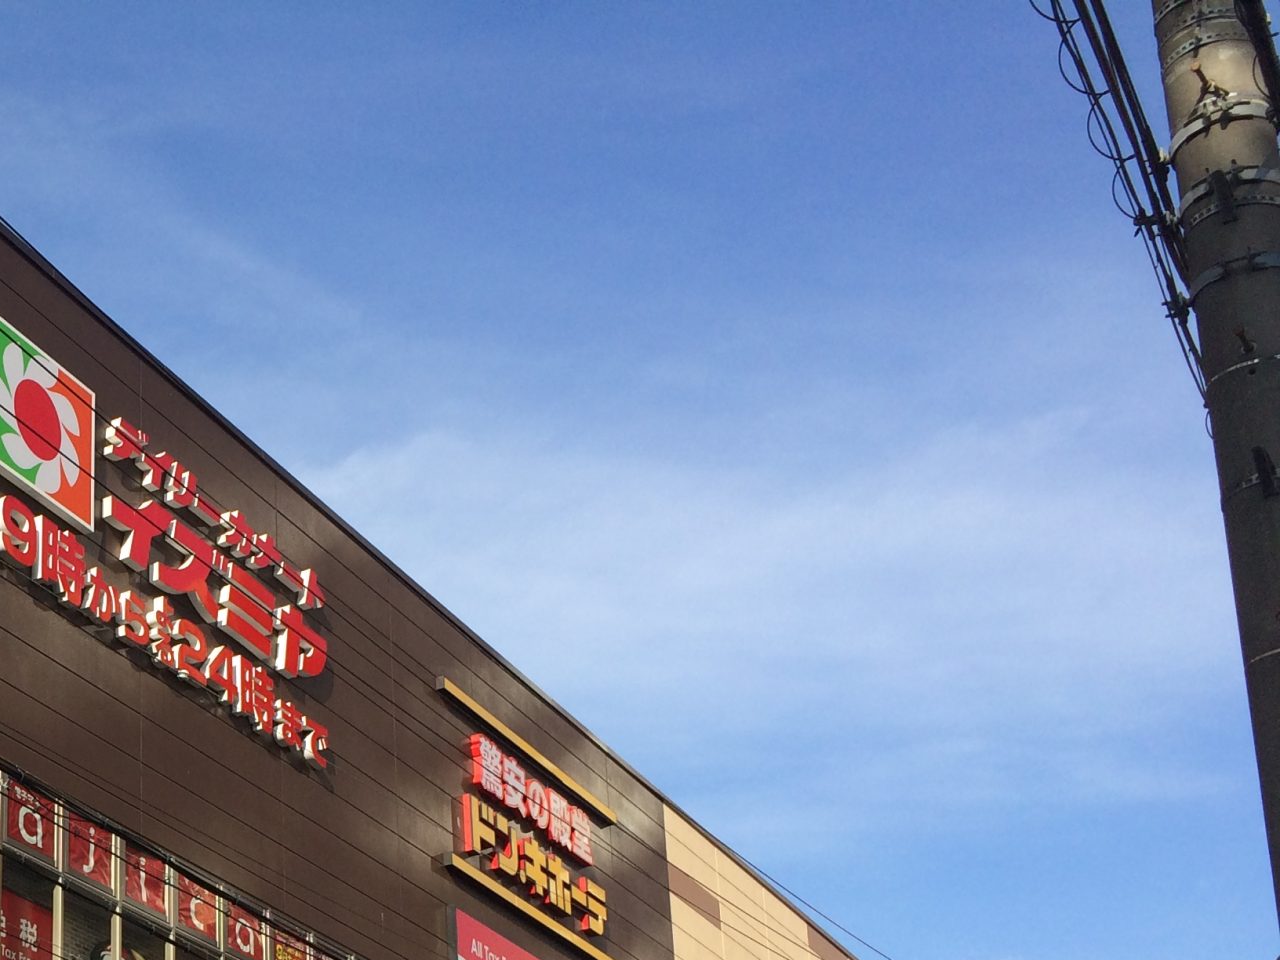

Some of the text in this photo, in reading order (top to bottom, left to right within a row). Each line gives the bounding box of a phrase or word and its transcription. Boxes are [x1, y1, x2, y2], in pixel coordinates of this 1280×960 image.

[104, 417, 326, 609] デイリーカナート
[102, 495, 327, 678] イズミヤ
[470, 733, 593, 866] 驚安の殿堂
[1, 944, 17, 960] Tax
[471, 938, 483, 959] All
